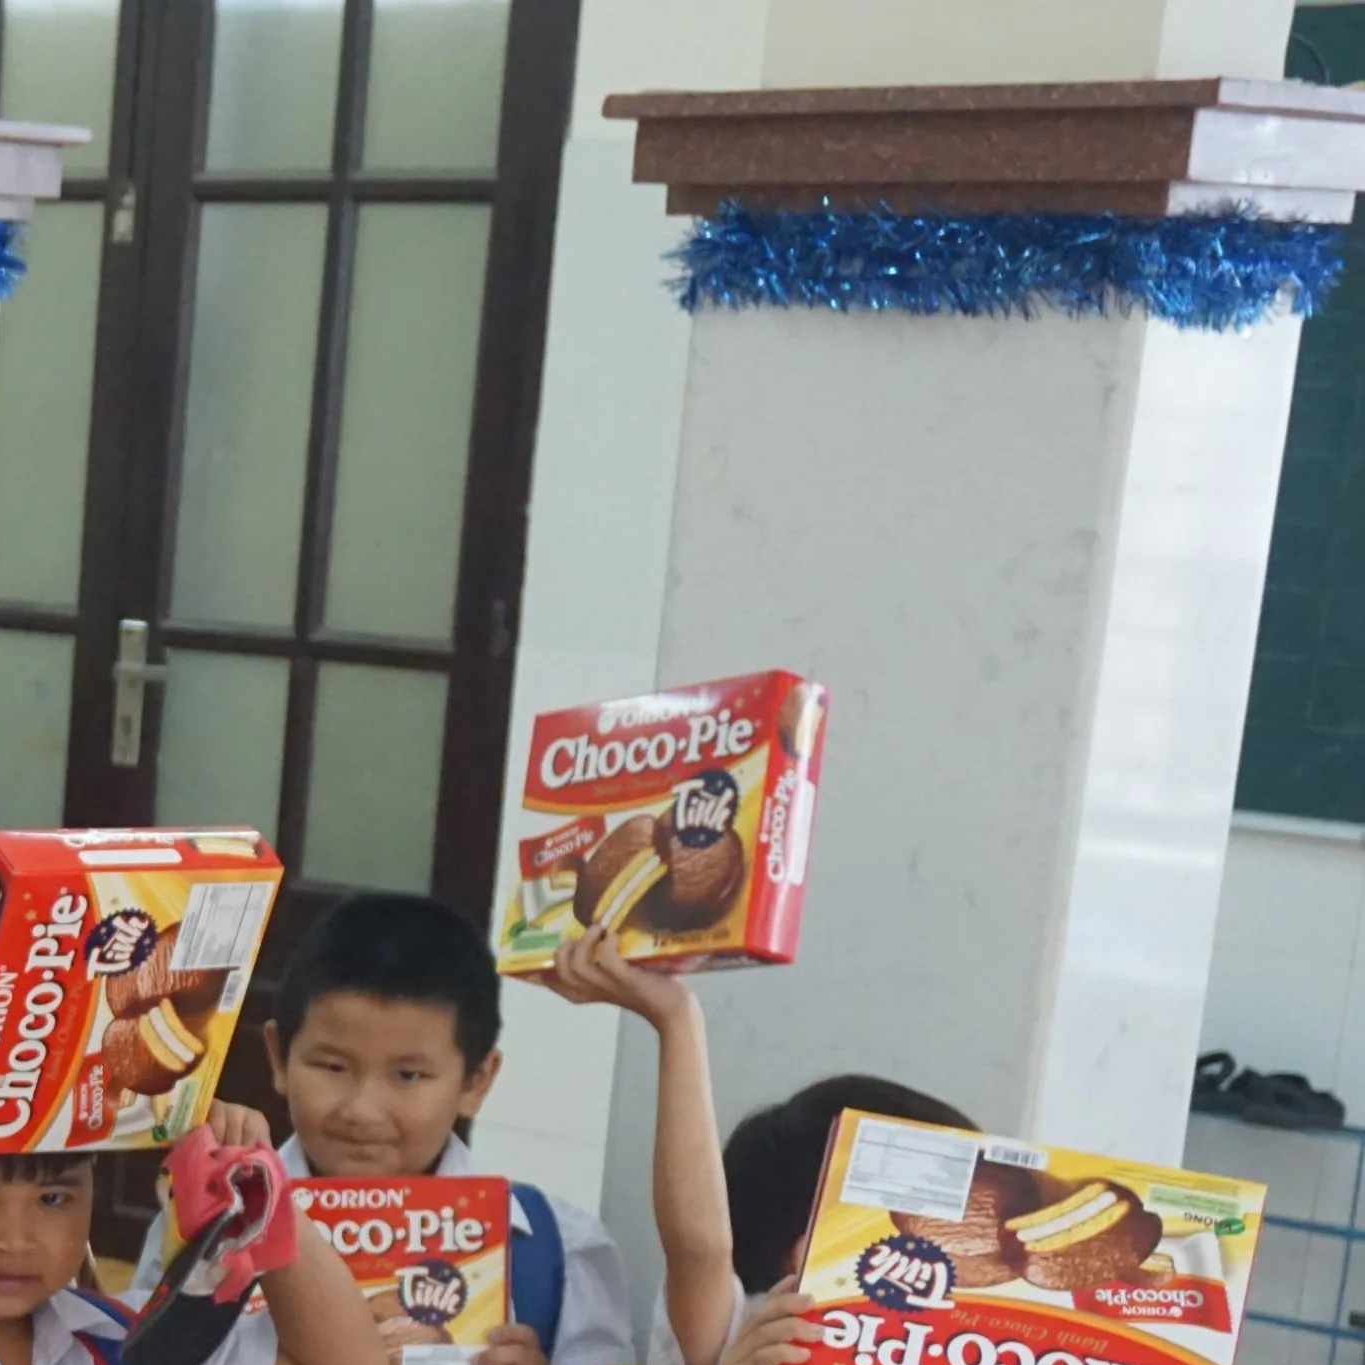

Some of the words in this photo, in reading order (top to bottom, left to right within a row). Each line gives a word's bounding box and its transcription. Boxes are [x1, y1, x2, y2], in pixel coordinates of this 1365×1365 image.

[540, 709, 754, 789] Choco·Pie
[319, 1188, 404, 1210] ORION
[869, 1243, 956, 1310] Tình
[1095, 1286, 1205, 1308] Choco·Pie
